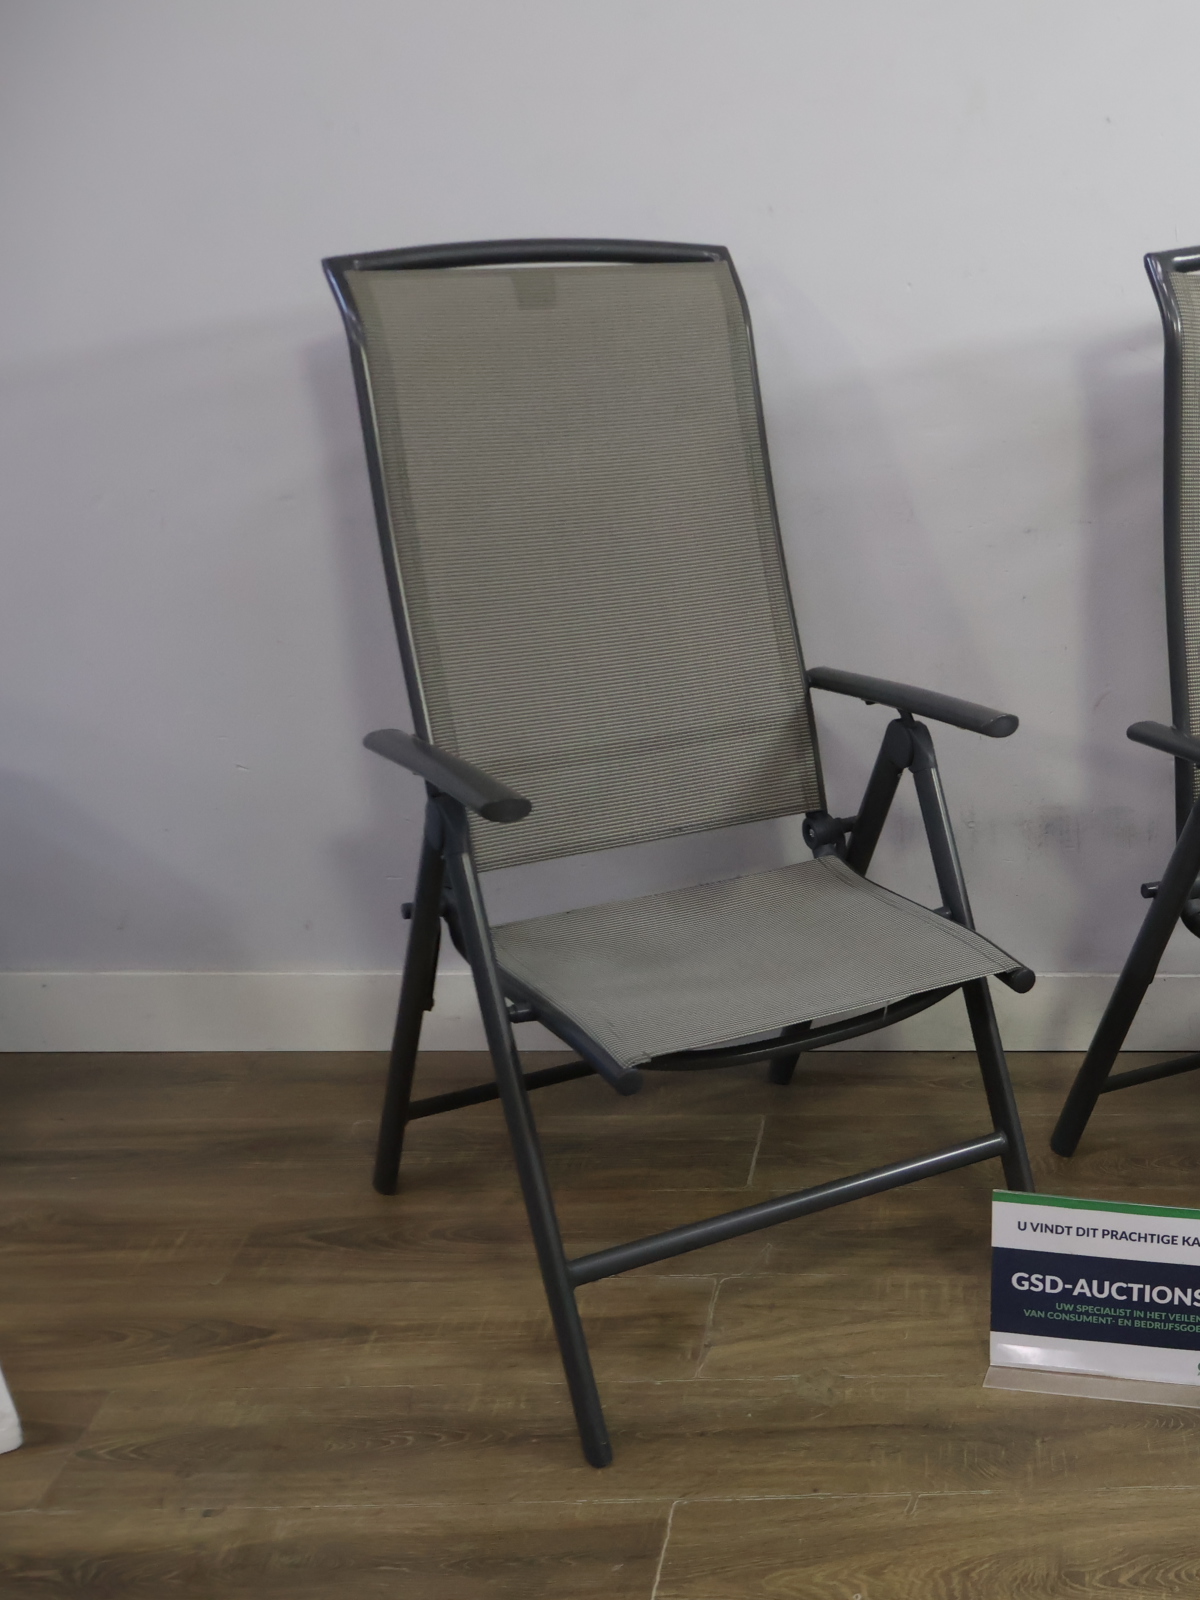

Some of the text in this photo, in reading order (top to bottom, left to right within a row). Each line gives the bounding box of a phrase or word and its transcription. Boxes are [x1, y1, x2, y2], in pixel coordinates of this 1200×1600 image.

[1018, 1221, 1027, 1231] U
[1030, 1222, 1073, 1236] VINDT
[1076, 1226, 1099, 1238] DIT
[1102, 1229, 1178, 1246] PRACHTIGE
[1024, 1309, 1045, 1318] VAN
[1047, 1311, 1116, 1324] CONSUMENT-
[1118, 1318, 1132, 1327] EN
[1056, 1303, 1074, 1312] UW
[1076, 1304, 1131, 1317] SPECIALIST
[1134, 1310, 1144, 1318] IN
[1147, 1312, 1166, 1320] HET
